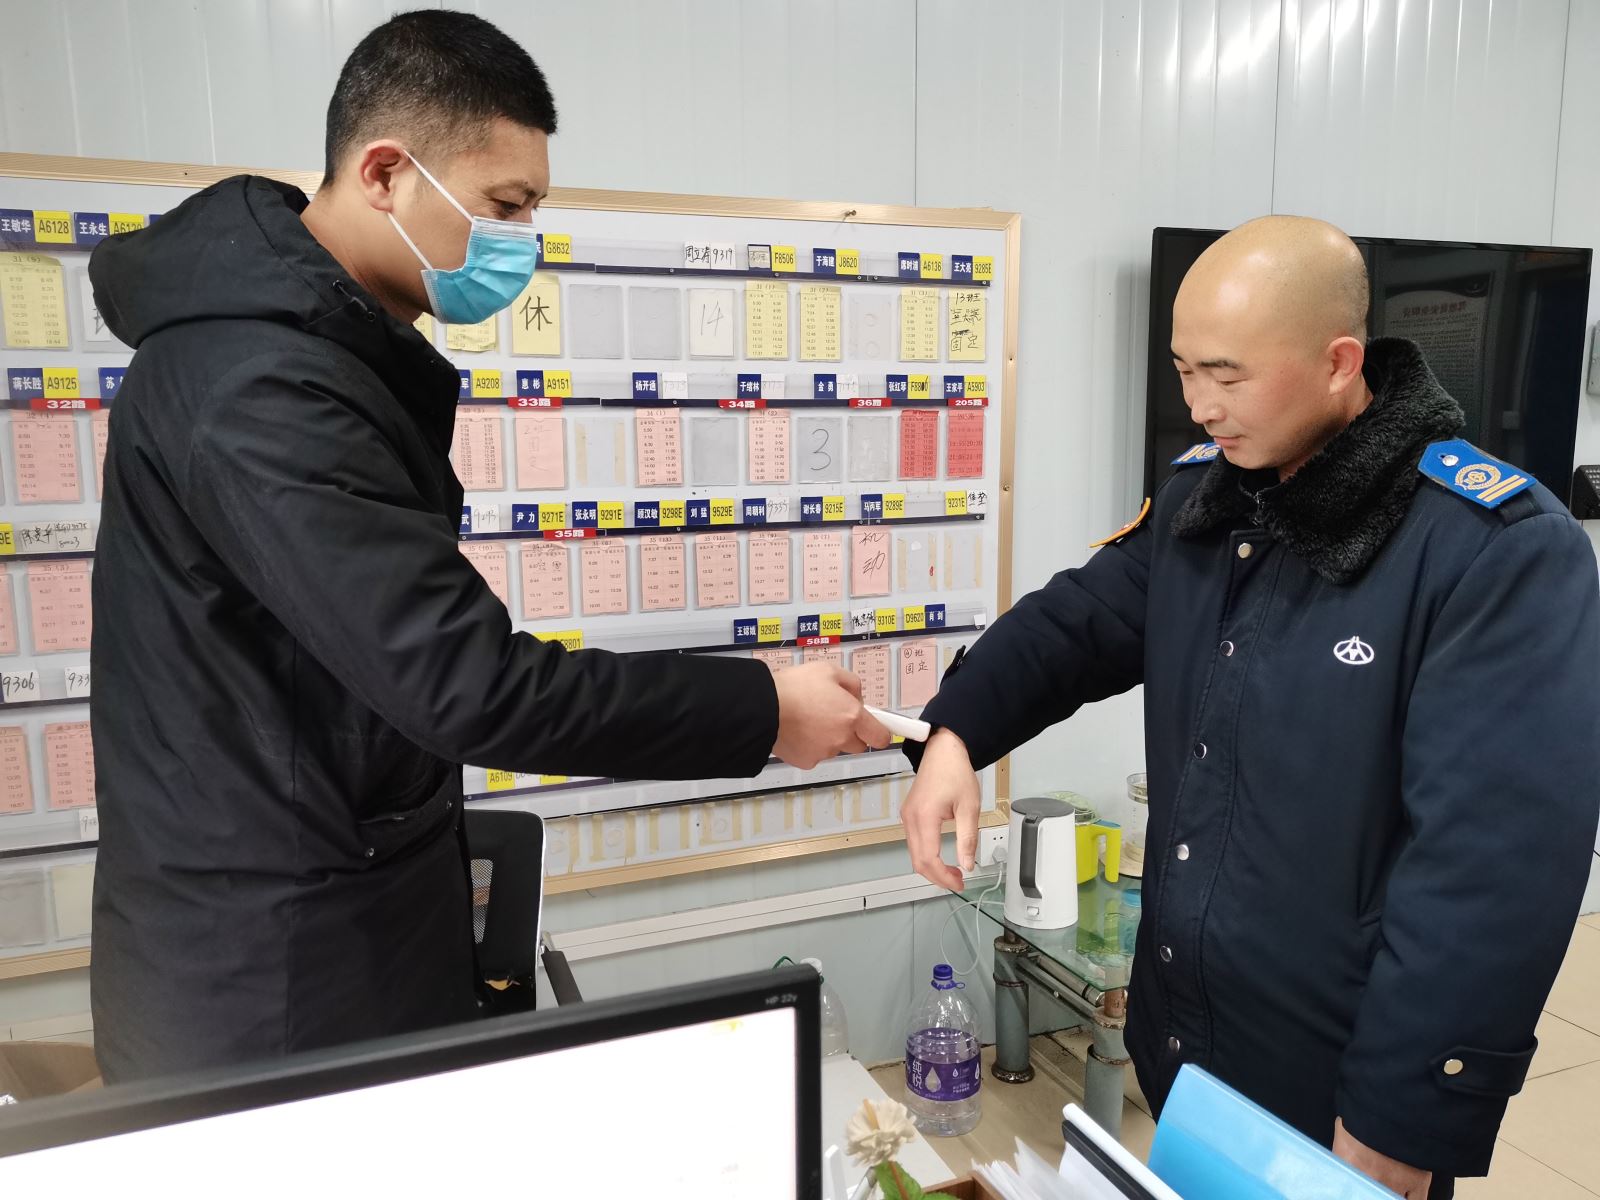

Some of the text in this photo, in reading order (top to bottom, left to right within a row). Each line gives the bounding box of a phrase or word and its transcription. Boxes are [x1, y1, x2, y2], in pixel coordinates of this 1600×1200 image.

[1, 218, 31, 233] 王敏华
[38, 221, 69, 234] A6128
[79, 222, 108, 236] 王永生
[546, 242, 570, 254] G8632
[774, 251, 794, 265] F8506
[838, 256, 858, 268] J8620
[923, 260, 942, 272] A6136
[953, 262, 972, 274] 王大亮
[519, 295, 552, 331] 休
[700, 300, 724, 336] 14
[47, 377, 77, 390] A9125
[476, 377, 500, 389] A9208
[547, 377, 569, 389] A9151
[810, 428, 831, 471] 3
[712, 507, 733, 516] 9529E
[825, 503, 843, 513] 9215E
[542, 511, 563, 523] 9271E
[575, 509, 596, 520] 张永明
[600, 510, 622, 520] 9291E
[822, 619, 841, 630] 9286E
[2, 672, 35, 697] 9306
